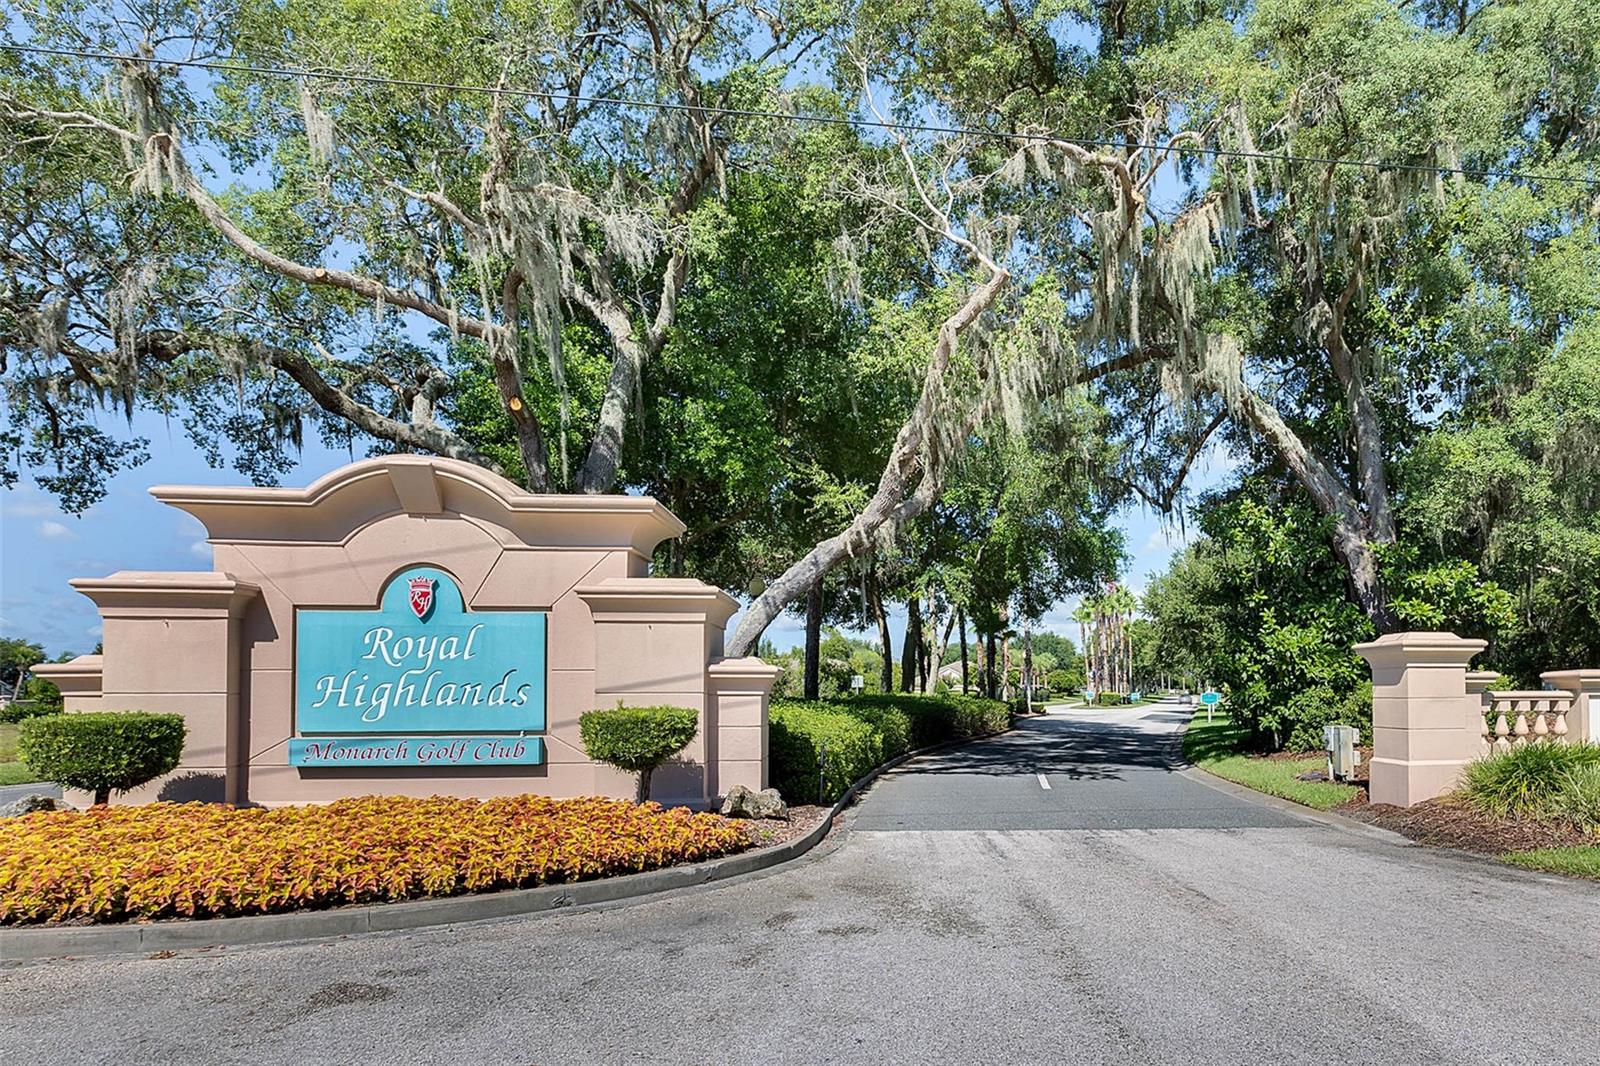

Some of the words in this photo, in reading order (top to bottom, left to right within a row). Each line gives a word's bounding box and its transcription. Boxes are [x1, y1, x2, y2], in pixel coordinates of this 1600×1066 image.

[361, 623, 485, 671] Royal
[312, 668, 532, 723] Highlands
[303, 741, 408, 762] Monarch
[416, 740, 471, 762] Golf
[473, 740, 526, 760] Club
